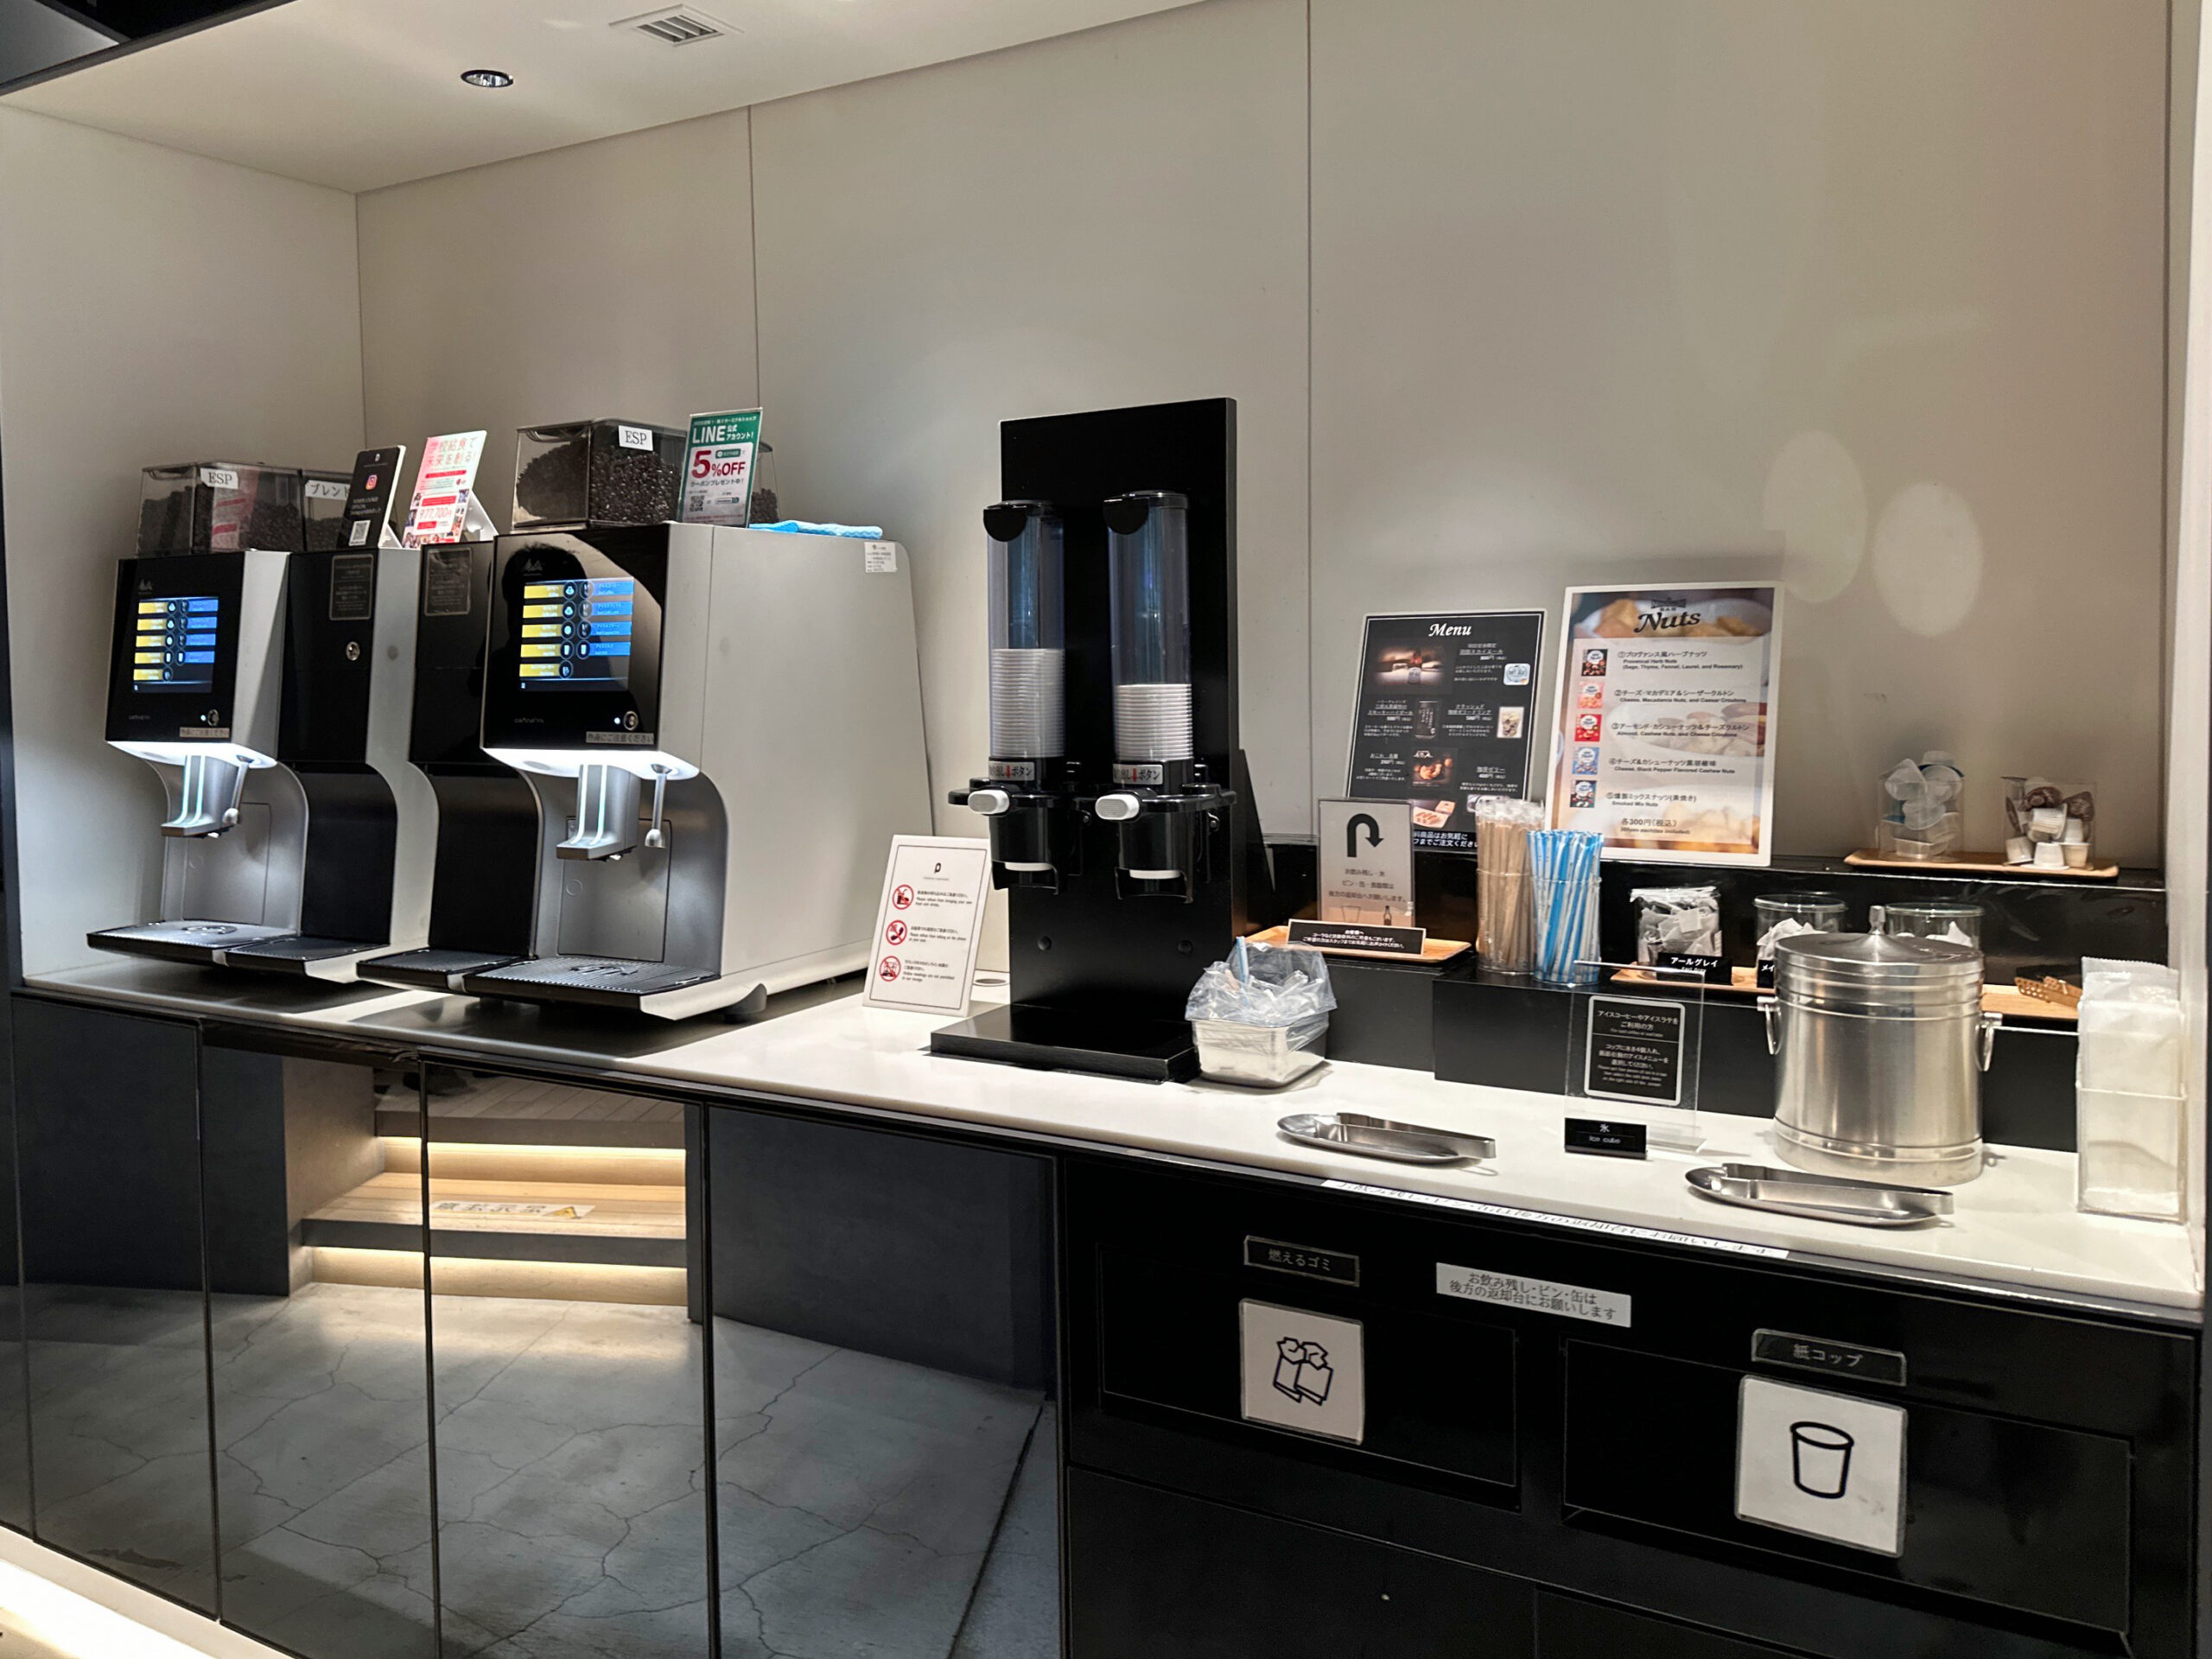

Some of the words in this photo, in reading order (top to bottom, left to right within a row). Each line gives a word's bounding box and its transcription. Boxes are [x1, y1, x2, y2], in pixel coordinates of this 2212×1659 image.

[624, 429, 647, 446] ESP
[692, 425, 727, 444] LINE
[206, 472, 232, 485] ESP
[1428, 623, 1472, 637] Menu
[1634, 612, 1701, 633] Nuts
[1139, 768, 1160, 780] ボタン
[1670, 957, 1719, 968] アールグレイ
[1268, 1247, 1332, 1272] 燃えるゴミ
[1449, 1279, 1618, 1320] 後方の返却台にお願いします
[1793, 1343, 1865, 1368] 紙コップ
